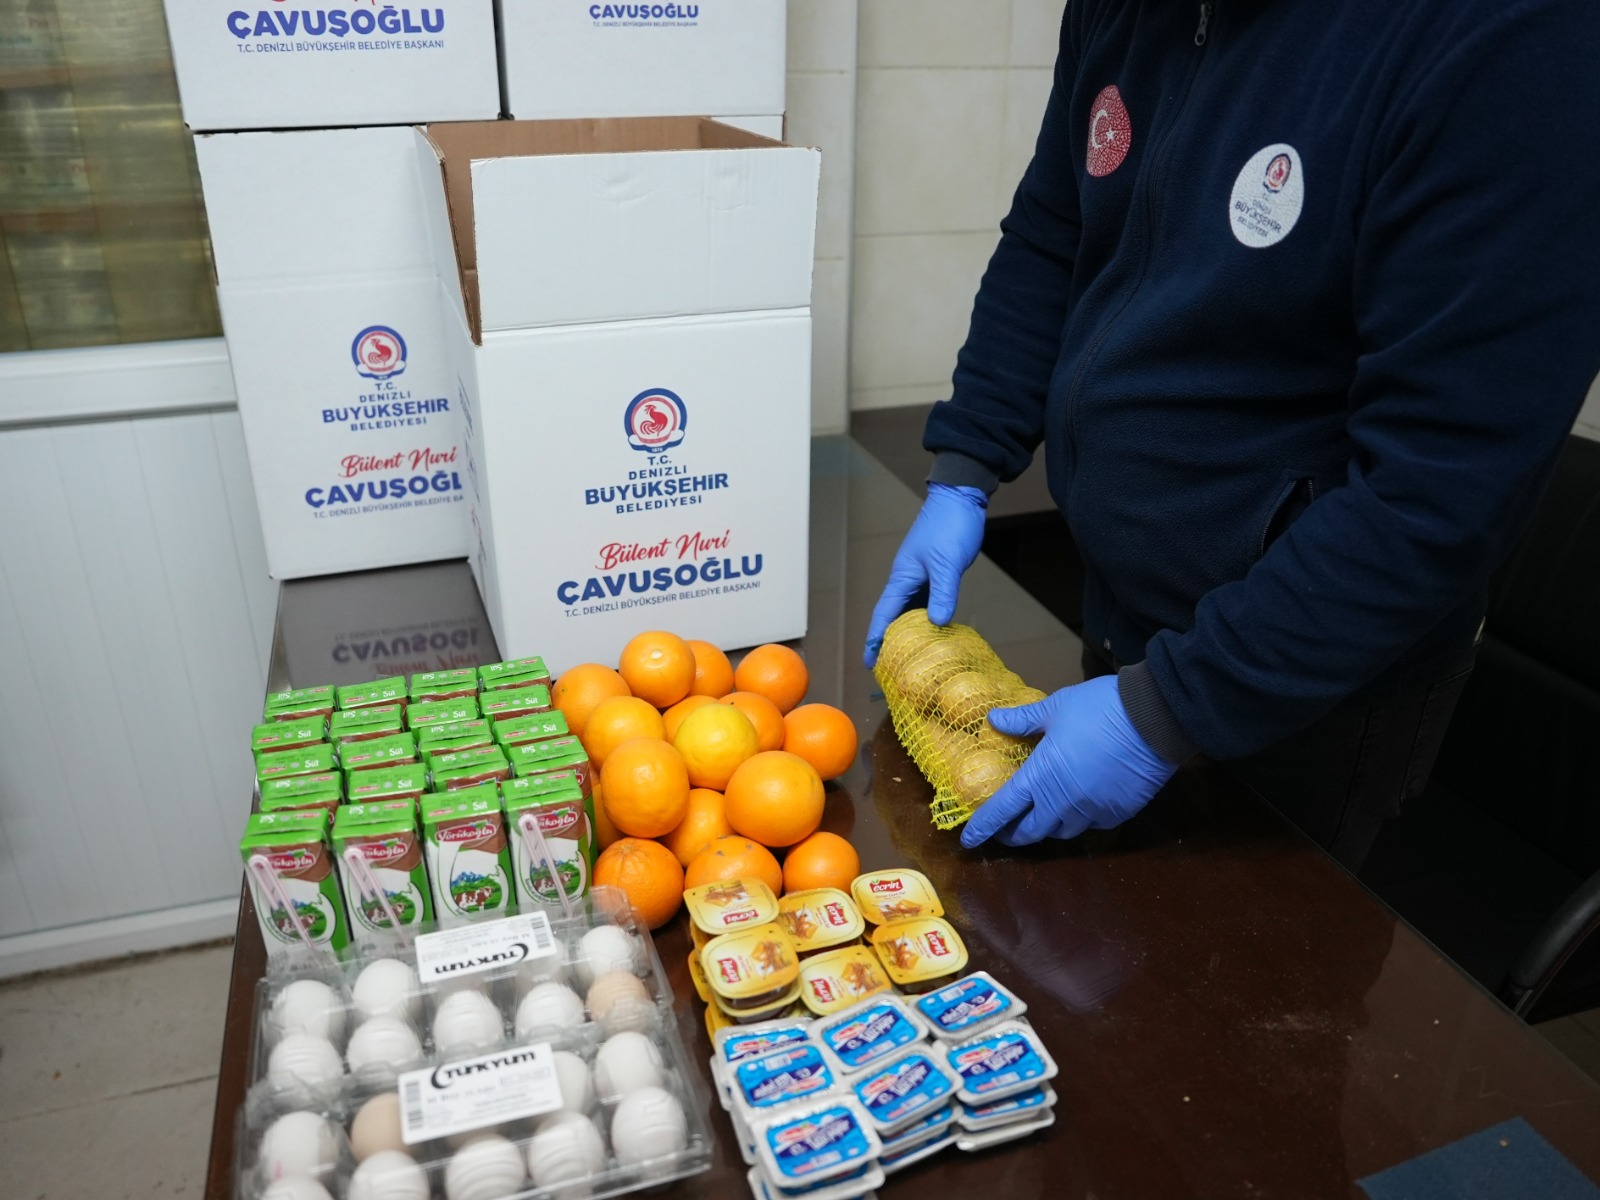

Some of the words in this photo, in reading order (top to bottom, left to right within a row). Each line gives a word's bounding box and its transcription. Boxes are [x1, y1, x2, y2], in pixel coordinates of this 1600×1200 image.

[227, 5, 445, 39] ÇAVUŞOĞLU
[589, 3, 699, 19] ÇAVUŞOĞLU
[237, 44, 255, 53] T.C.
[256, 42, 294, 53] DENİZLİ
[297, 41, 356, 52] BÜYÜKŞEHİR
[358, 40, 402, 50] BELEDİYE
[404, 39, 444, 49] BAŞKANI
[375, 382, 397, 391] T.C.
[338, 452, 405, 478] Bülent
[647, 455, 672, 466] T.C.
[305, 470, 463, 508] ÇAVUŞOĞL
[585, 473, 729, 505] BÜYÜKŞEHİR
[595, 538, 672, 571] Bülent
[675, 529, 731, 561] Nuri
[557, 553, 763, 605] ÇAVUŞOĞLU
[565, 608, 581, 617] T.C.
[583, 601, 619, 615] DENİZLİ
[620, 593, 677, 609] BÜYÜKŞEHİR
[679, 587, 721, 600] BELEDİYE
[723, 580, 760, 593] BAŞKANI
[873, 882, 902, 892] ecrin
[927, 933, 948, 955] ecrin
